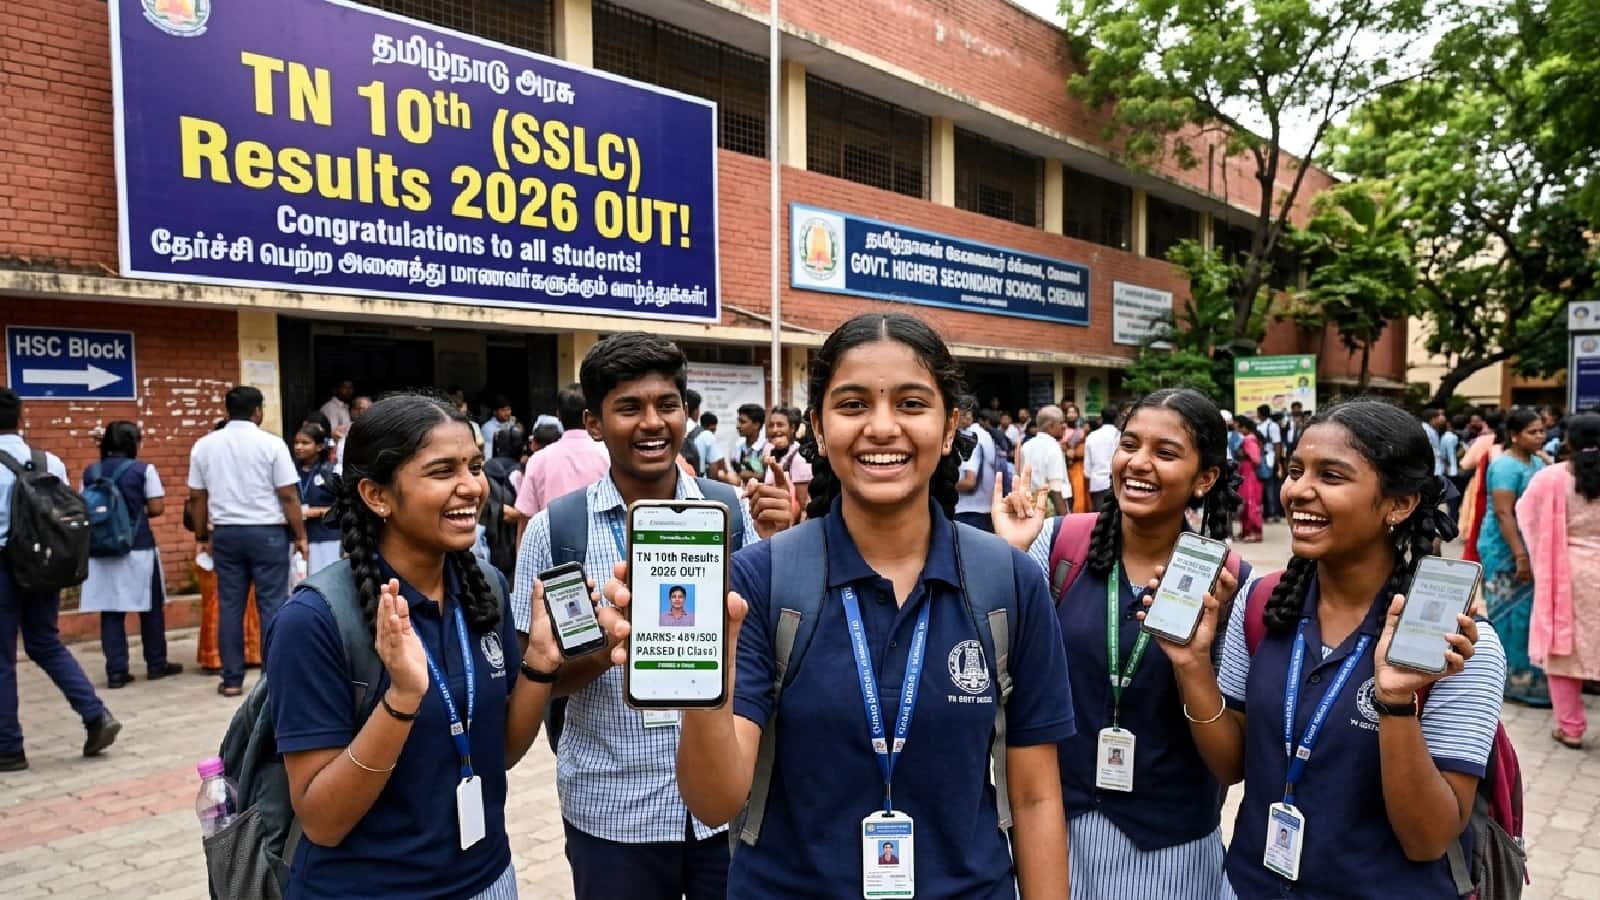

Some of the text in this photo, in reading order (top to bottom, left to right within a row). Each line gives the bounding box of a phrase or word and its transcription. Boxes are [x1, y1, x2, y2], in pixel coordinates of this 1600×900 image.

[372, 33, 575, 104] தமிழ்நாடு அரசு
[240, 51, 642, 193] TN 10th (SSLC)
[179, 115, 691, 248] Results 2026 OUT!
[151, 228, 255, 264] தேர்ச்சி
[260, 242, 333, 276] பெற்ற
[338, 251, 447, 287] அனைத்து
[276, 204, 642, 273] Congratulations to all students!
[851, 252, 890, 279] GOVT.
[893, 259, 938, 286] HIGHER
[940, 266, 1004, 295] SECONDARY
[16, 335, 126, 359] HSC Block
[636, 551, 720, 563] TN 10th Results
[650, 566, 706, 578] 2026 OUT!
[635, 632, 675, 642] MARKS:
